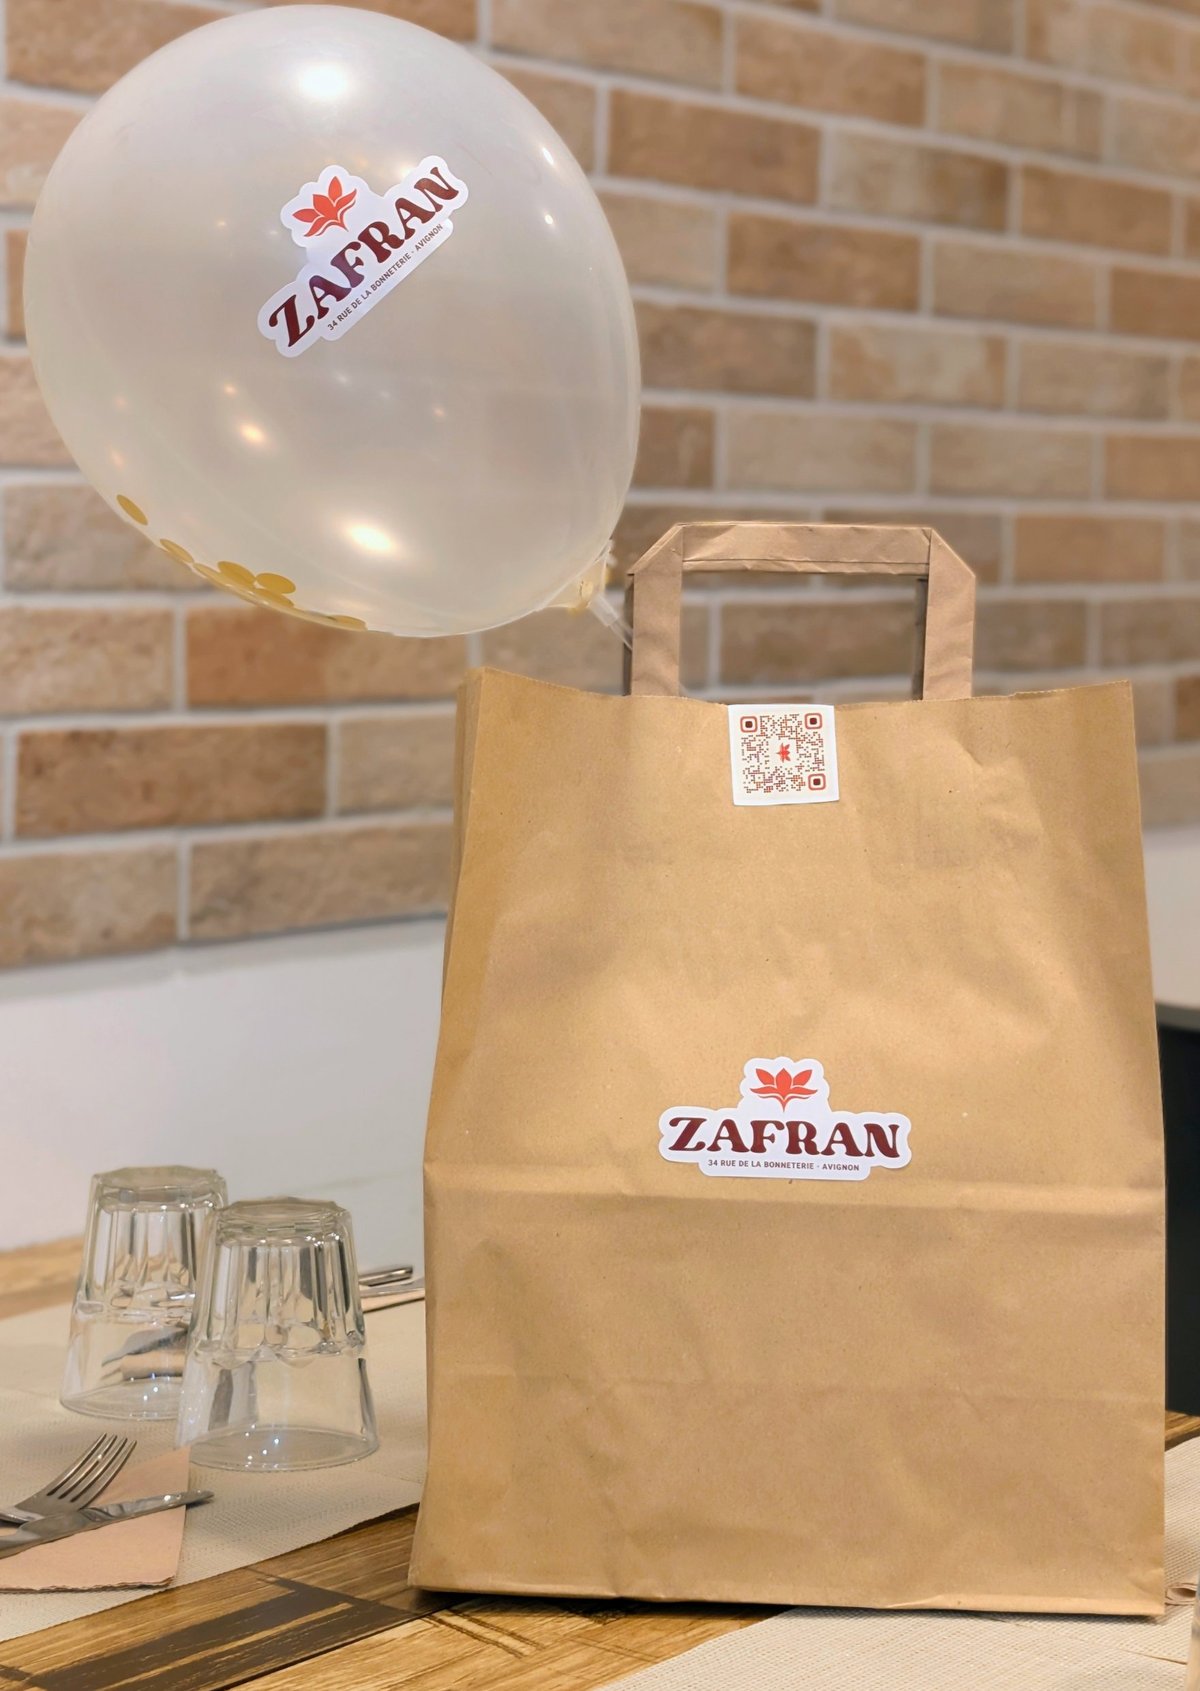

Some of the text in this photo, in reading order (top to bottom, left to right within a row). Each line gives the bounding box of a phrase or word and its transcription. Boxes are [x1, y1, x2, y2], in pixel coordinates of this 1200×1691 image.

[268, 166, 459, 347] ZAFRAN
[327, 320, 338, 331] 34
[337, 307, 352, 322] RUE
[351, 298, 362, 310] DE
[361, 290, 372, 301] LA
[370, 252, 412, 291] BONNETERIE
[415, 224, 443, 252] AVIGNON
[668, 1117, 900, 1158] ZAFRAN
[708, 1159, 718, 1167] 34
[720, 1159, 736, 1168] RUE
[738, 1160, 749, 1168] DE
[751, 1160, 762, 1168] LA
[763, 1161, 814, 1170] BONNETERIE
[822, 1163, 860, 1171] AVIGNON
